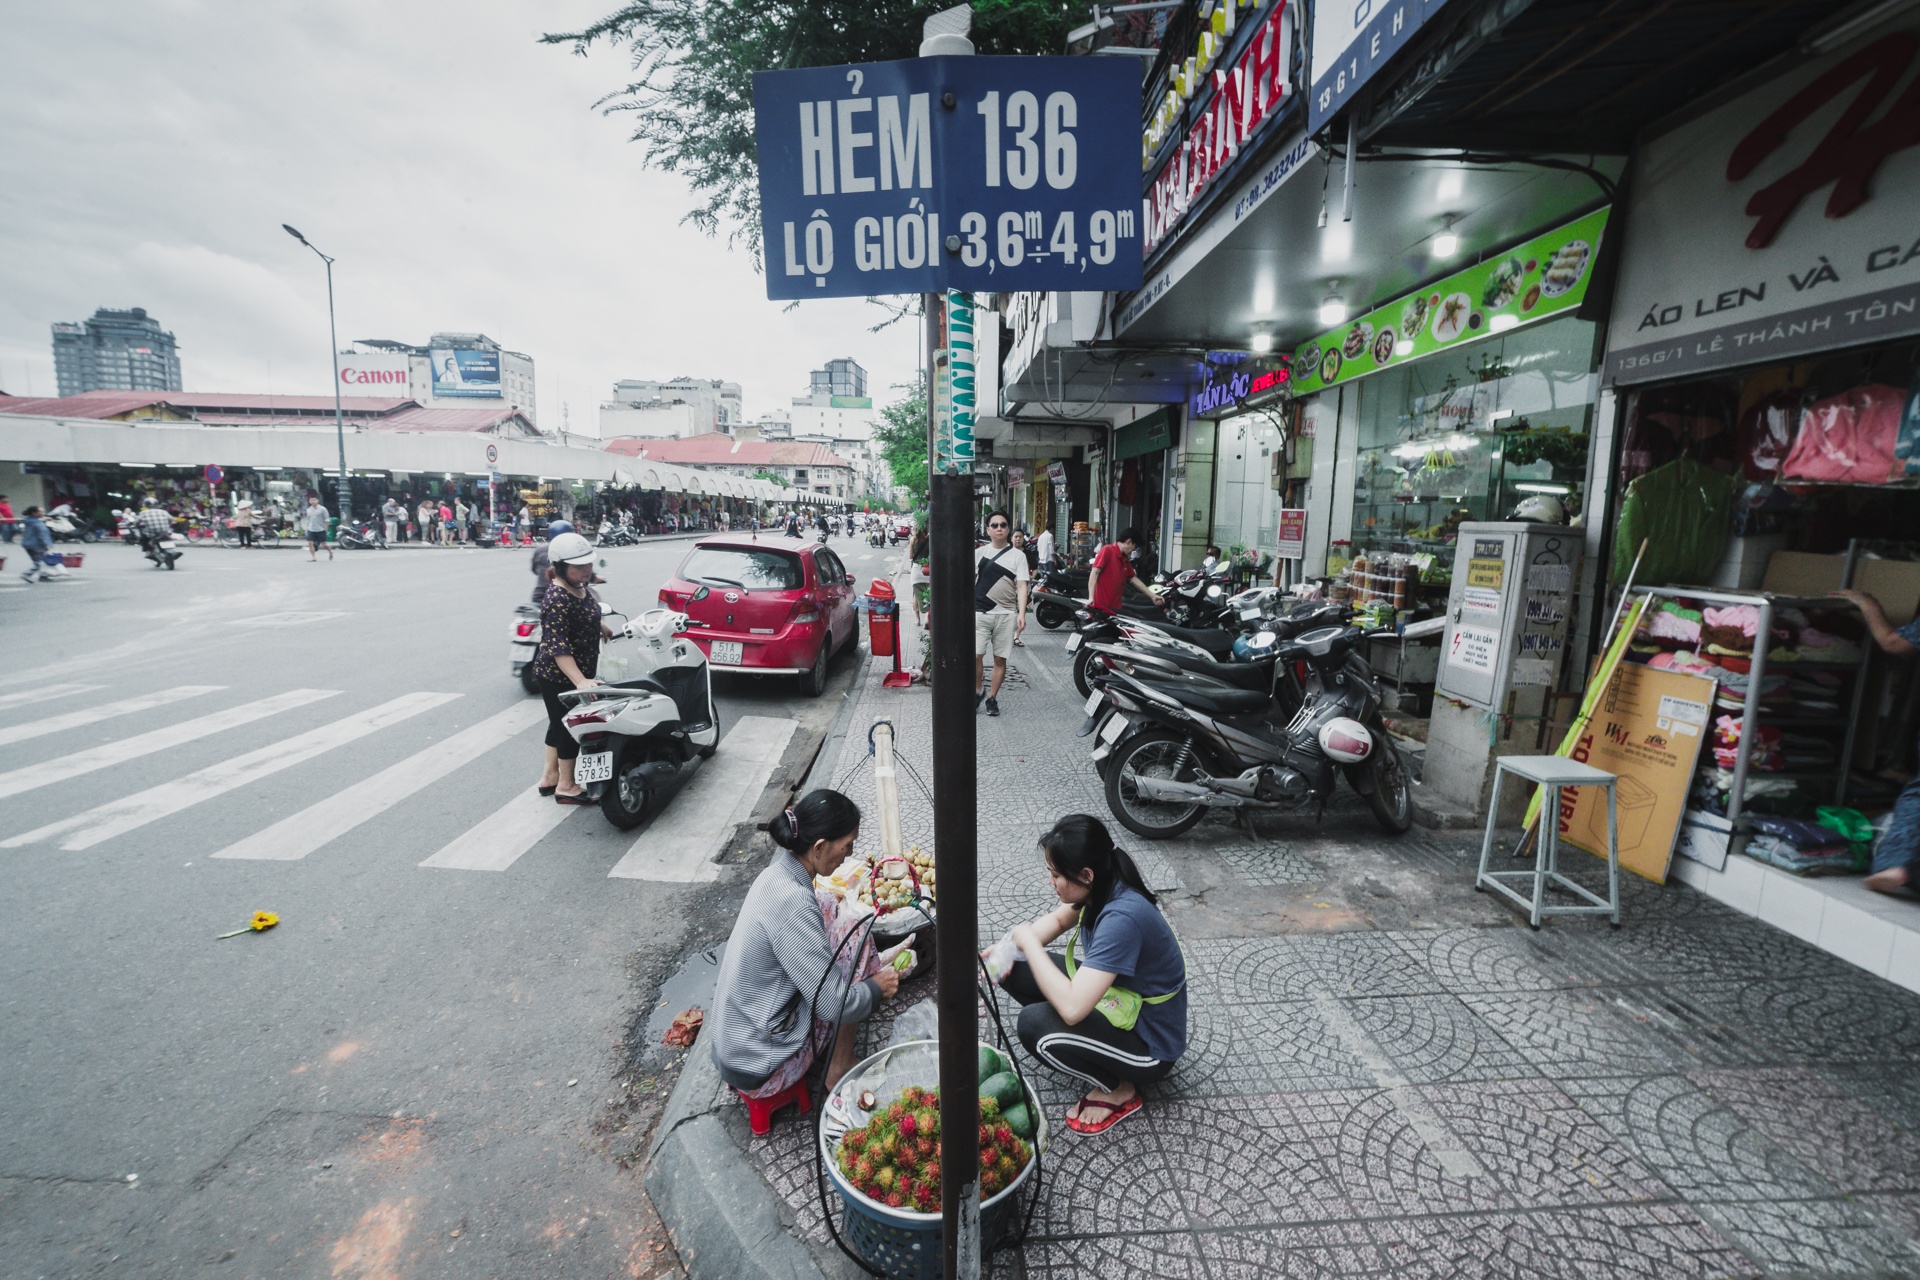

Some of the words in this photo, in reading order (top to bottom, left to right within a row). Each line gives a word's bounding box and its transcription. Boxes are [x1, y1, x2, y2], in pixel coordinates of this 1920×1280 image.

[800, 69, 932, 196] HẺM
[977, 90, 1078, 190] 136
[784, 209, 834, 287] LỘ
[854, 197, 940, 273] GIỚI
[1637, 303, 1683, 332] ÁO
[1695, 282, 1766, 318] LEN
[1787, 256, 1840, 292] VÀ
[1618, 346, 1684, 371] 136G/1
[1696, 334, 1724, 357] LÊ
[1733, 315, 1832, 348] THÁNH
[1844, 298, 1916, 325] TÔN
[340, 367, 407, 385] Canon
[711, 651, 740, 663] 356.92
[718, 642, 735, 653] 51A
[578, 766, 610, 782] 578.25
[582, 754, 606, 769] 59-M1
[1558, 734, 1594, 834] TOHIBA
